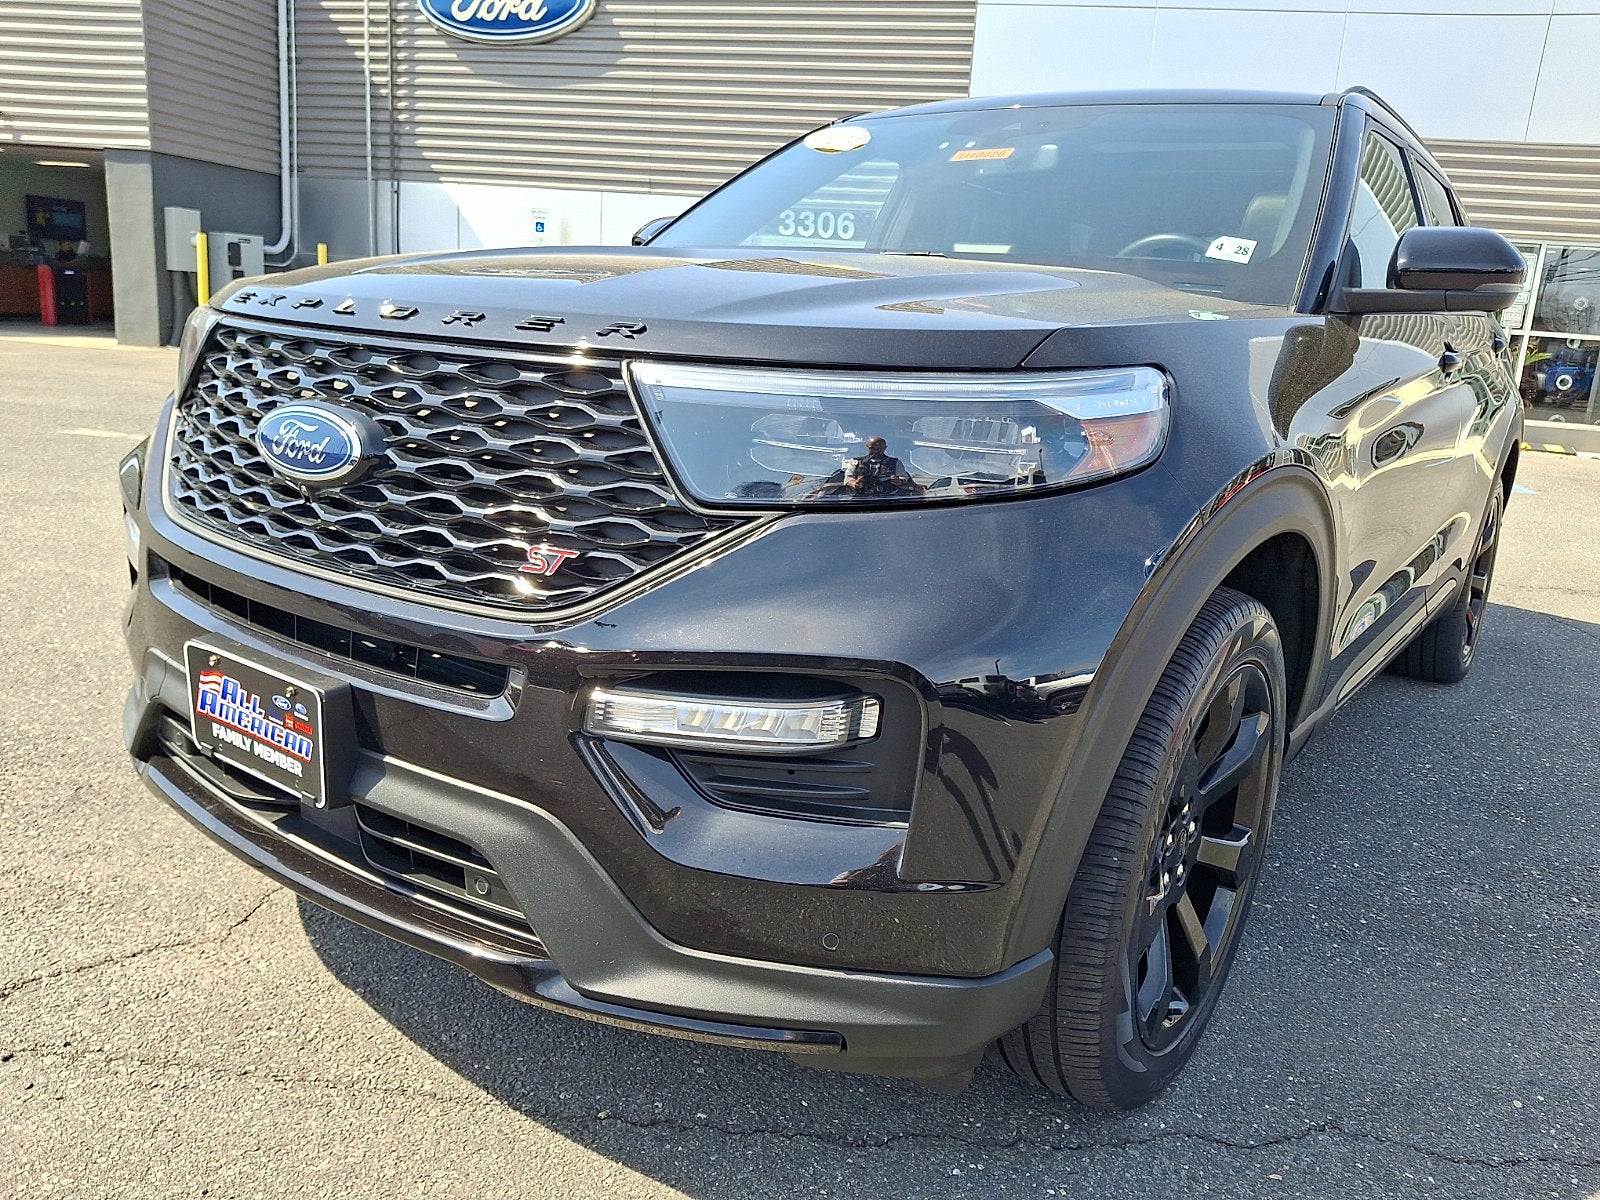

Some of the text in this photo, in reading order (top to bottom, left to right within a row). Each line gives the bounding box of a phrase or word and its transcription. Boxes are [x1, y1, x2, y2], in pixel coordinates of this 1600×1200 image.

[778, 209, 855, 240] 3306
[1215, 243, 1250, 255] 4 28
[232, 291, 649, 340] EXPLORER
[271, 420, 331, 464] Ford
[518, 545, 580, 576] ST
[220, 677, 264, 718] ALL
[199, 689, 313, 761] AMERICAN
[211, 722, 303, 777] FAMILY MEMBER
